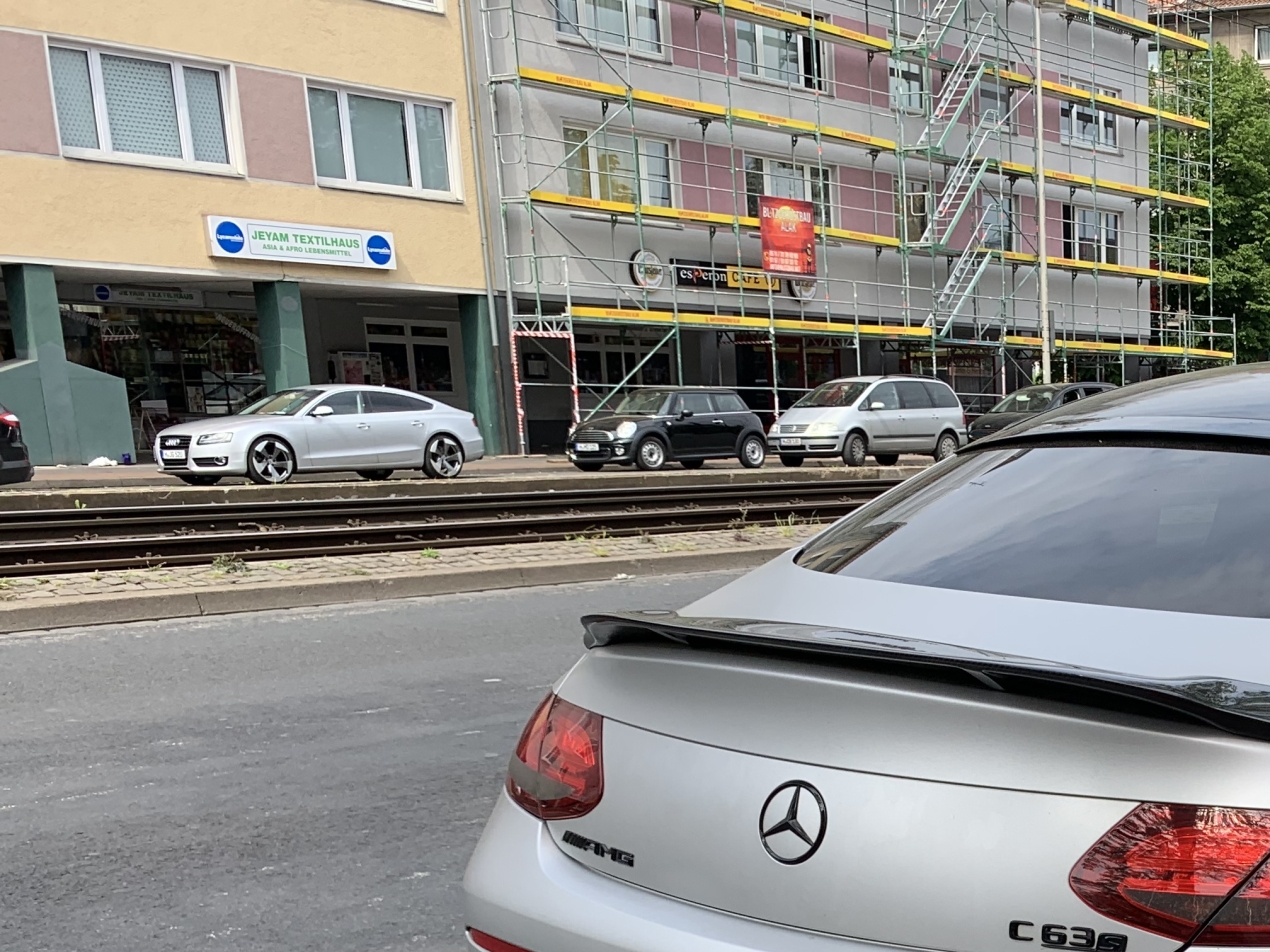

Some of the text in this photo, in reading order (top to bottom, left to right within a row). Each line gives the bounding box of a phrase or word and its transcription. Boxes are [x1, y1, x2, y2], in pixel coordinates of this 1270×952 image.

[251, 230, 360, 249] JEYAM TEXTILHAUS
[262, 243, 278, 251] ASIA
[286, 245, 303, 253] AFRO
[305, 247, 352, 257] LEBENSMITTEL
[1008, 919, 1034, 942] C
